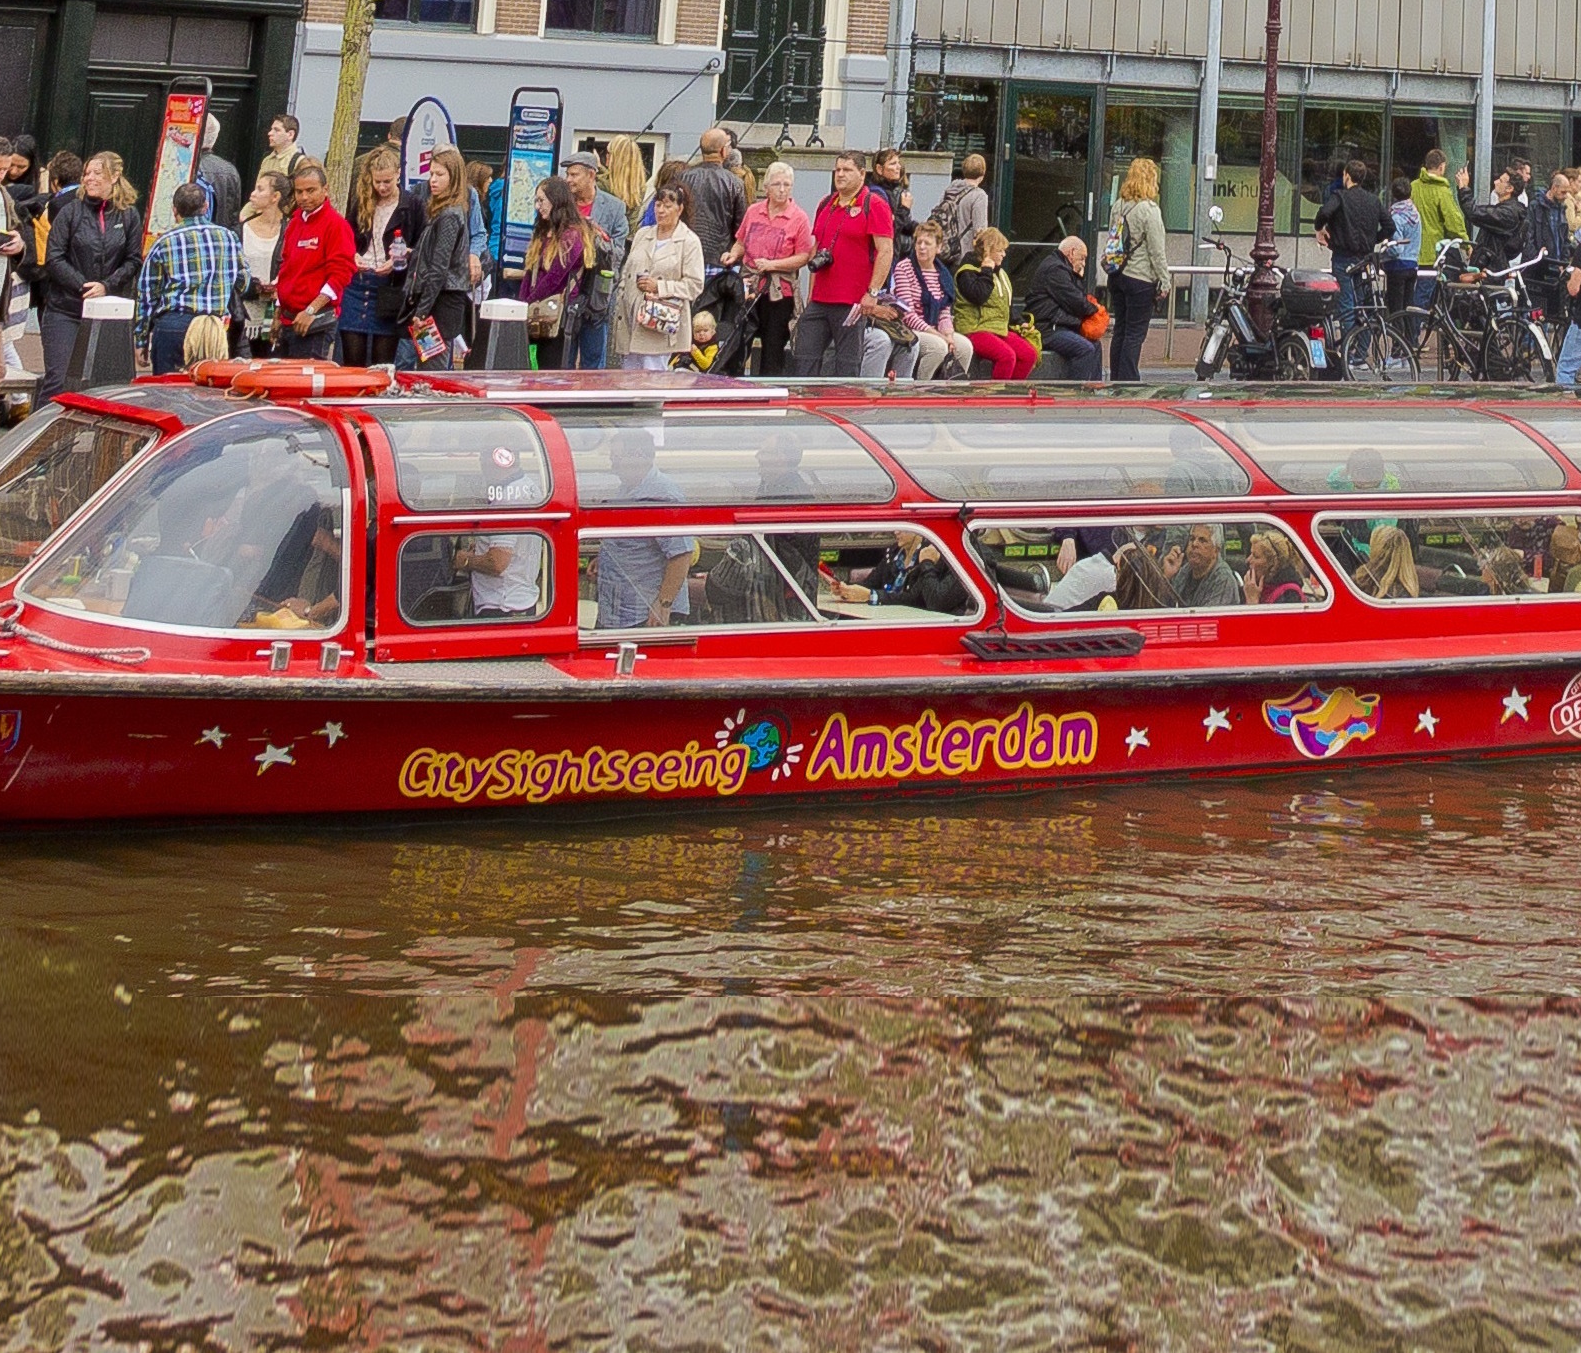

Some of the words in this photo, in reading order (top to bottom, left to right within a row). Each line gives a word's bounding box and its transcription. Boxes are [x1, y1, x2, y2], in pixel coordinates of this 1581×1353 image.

[488, 485, 503, 501] 96
[398, 740, 750, 802] CitySightseeing
[807, 701, 1098, 781] Amsterdam
